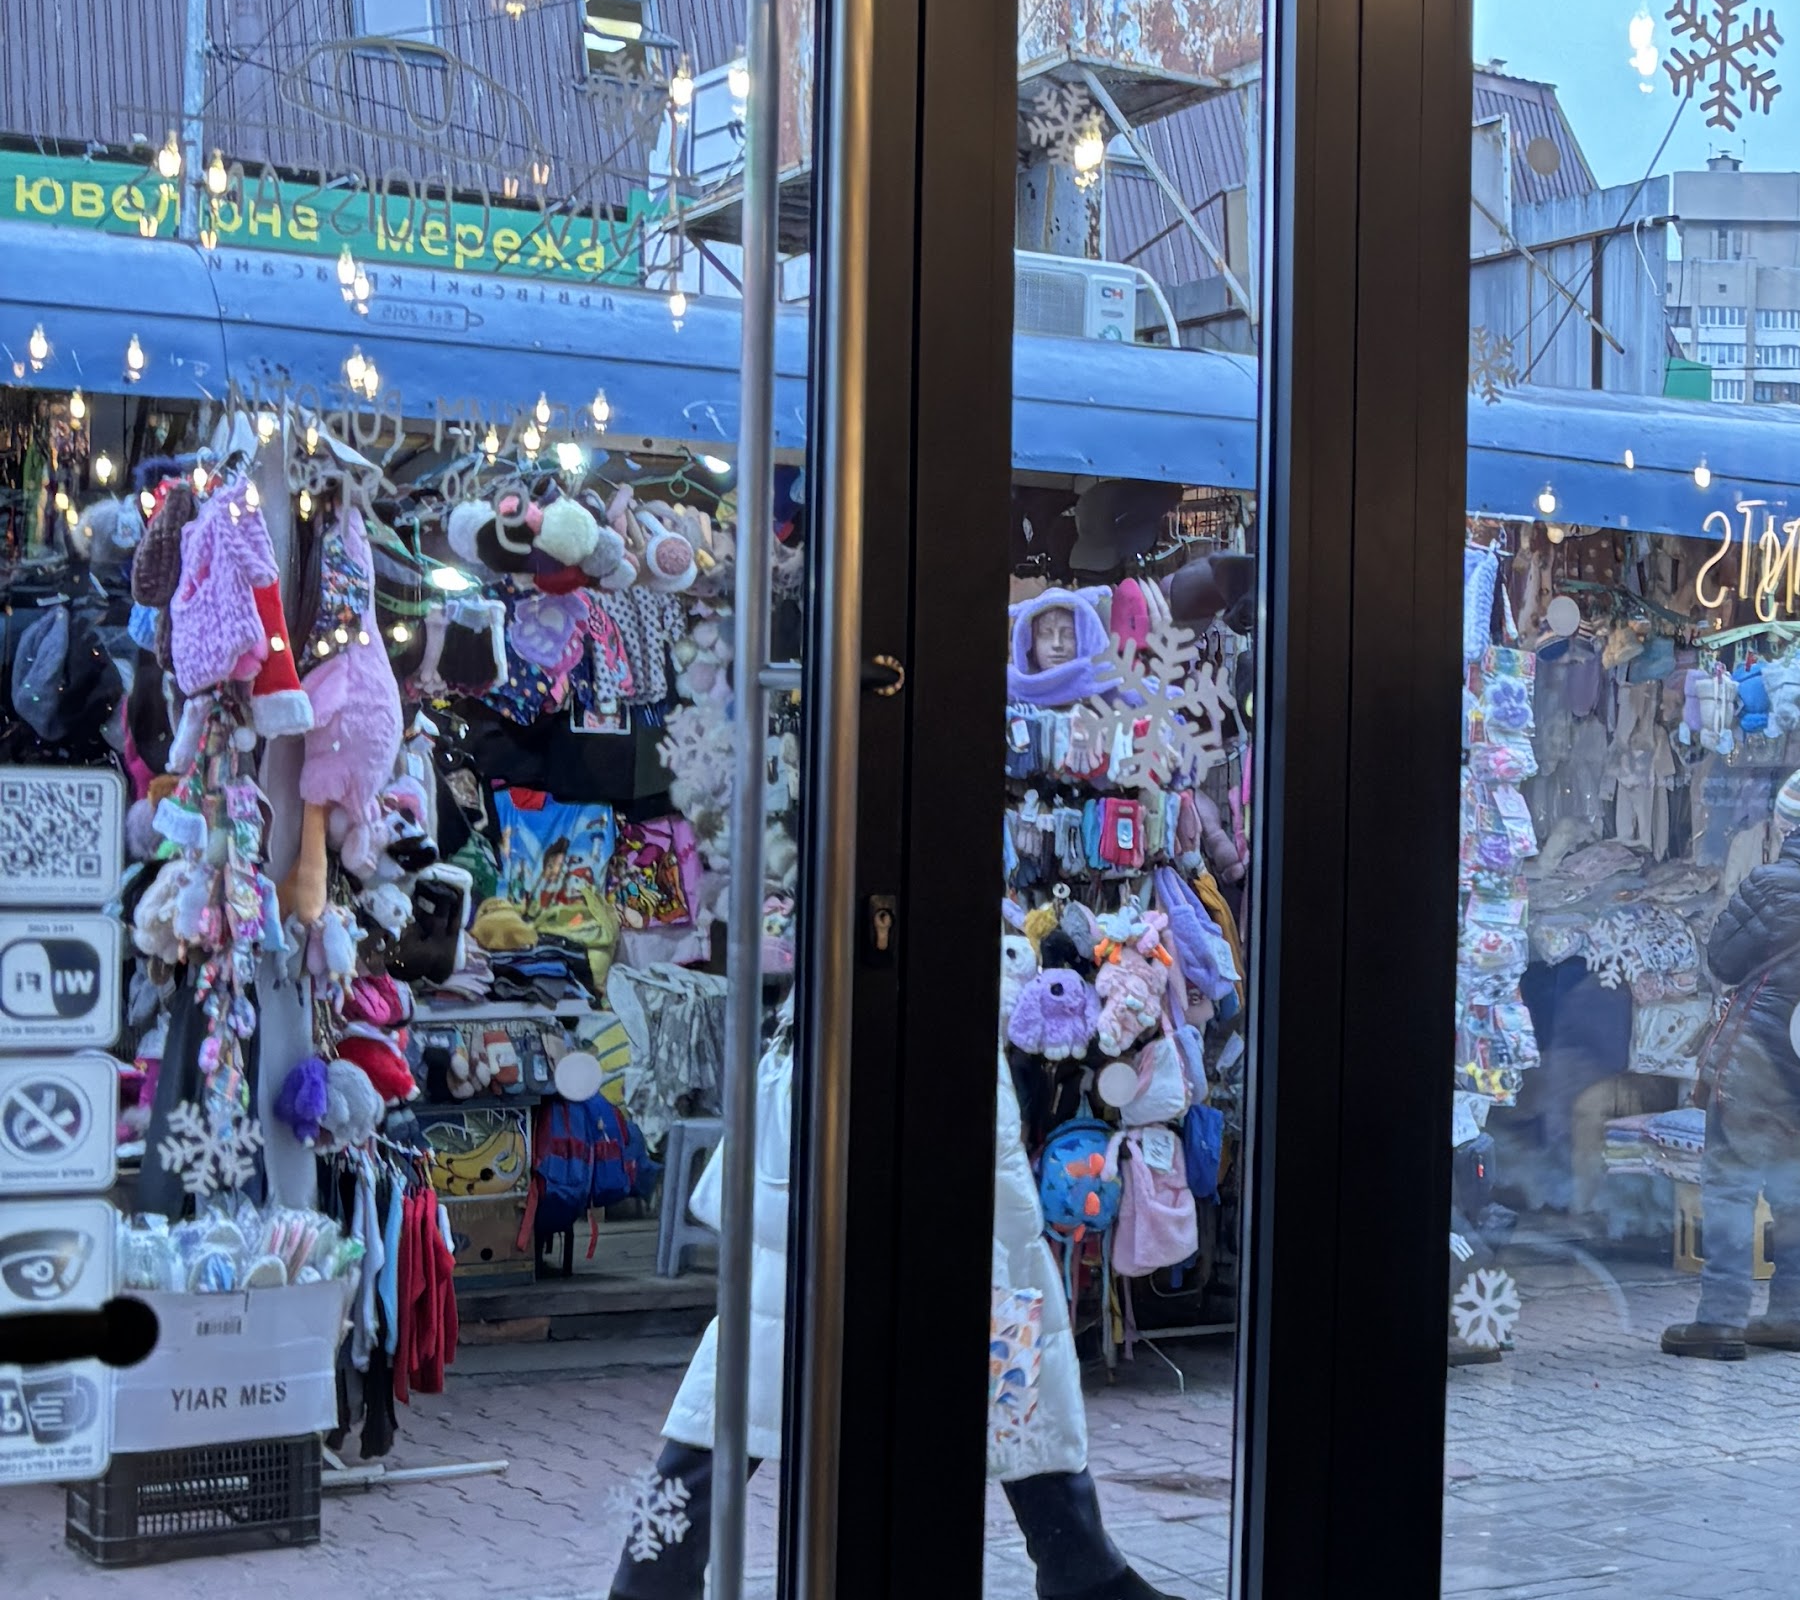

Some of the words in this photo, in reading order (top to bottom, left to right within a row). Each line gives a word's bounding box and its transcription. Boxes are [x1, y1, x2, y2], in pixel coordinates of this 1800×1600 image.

[14, 173, 320, 243] ювелрна
[376, 214, 606, 273] мережа
[171, 1386, 228, 1412] YIAR
[240, 1381, 287, 1407] MES
